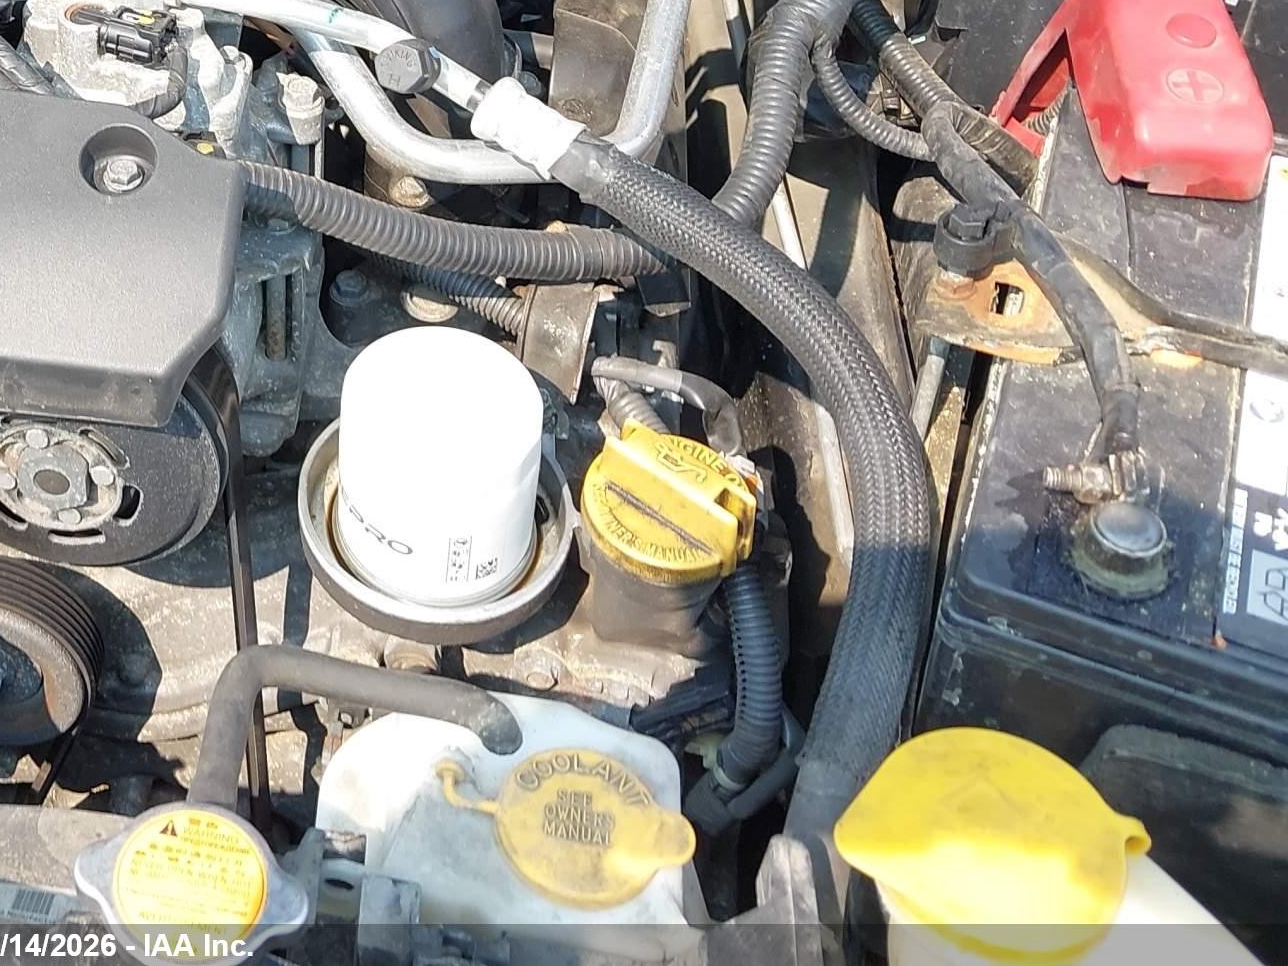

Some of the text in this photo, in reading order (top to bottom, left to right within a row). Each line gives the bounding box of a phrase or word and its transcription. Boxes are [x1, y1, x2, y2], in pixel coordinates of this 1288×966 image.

[516, 753, 652, 807] COOLANT
[556, 789, 593, 807] SEE
[543, 820, 611, 847] MANUAL
